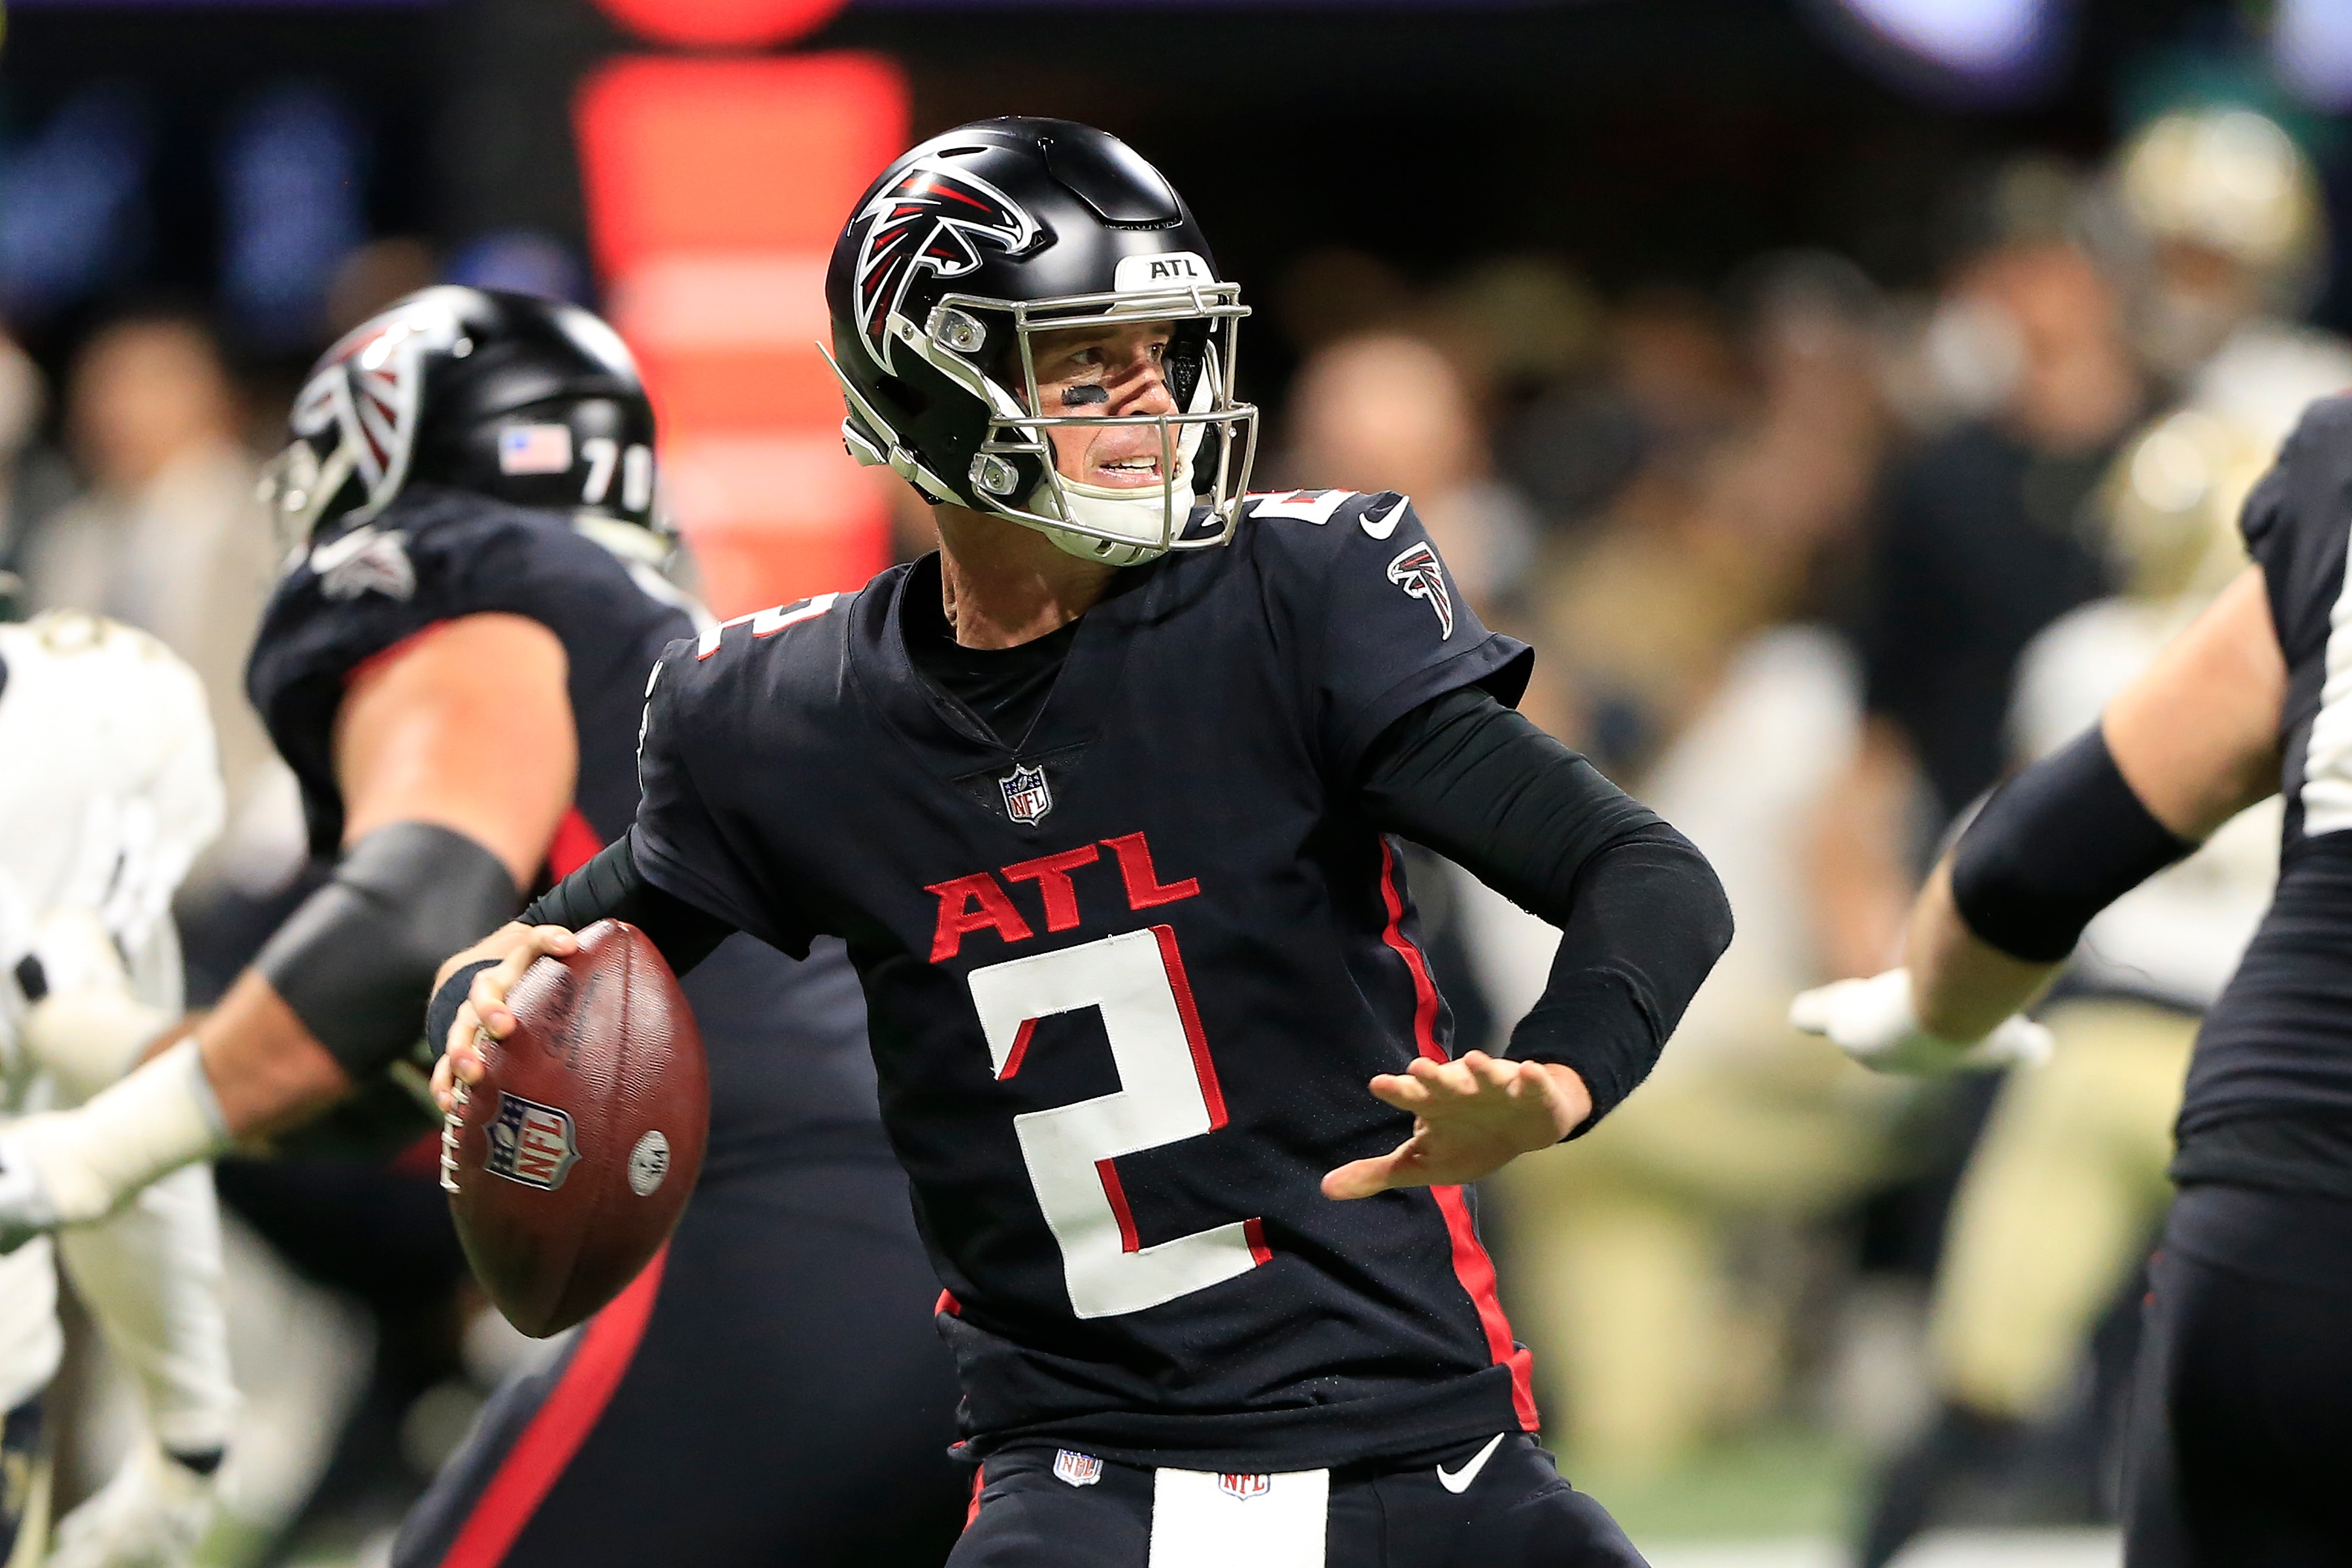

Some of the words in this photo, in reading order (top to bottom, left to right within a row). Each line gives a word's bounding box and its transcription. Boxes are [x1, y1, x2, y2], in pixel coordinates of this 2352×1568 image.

[1149, 259, 1198, 279] ATL
[1010, 790, 1045, 816] NFL
[923, 830, 1201, 964] ATL
[966, 923, 1273, 1320] 2
[518, 1117, 564, 1181] NFL
[1061, 1455, 1094, 1477] NFL
